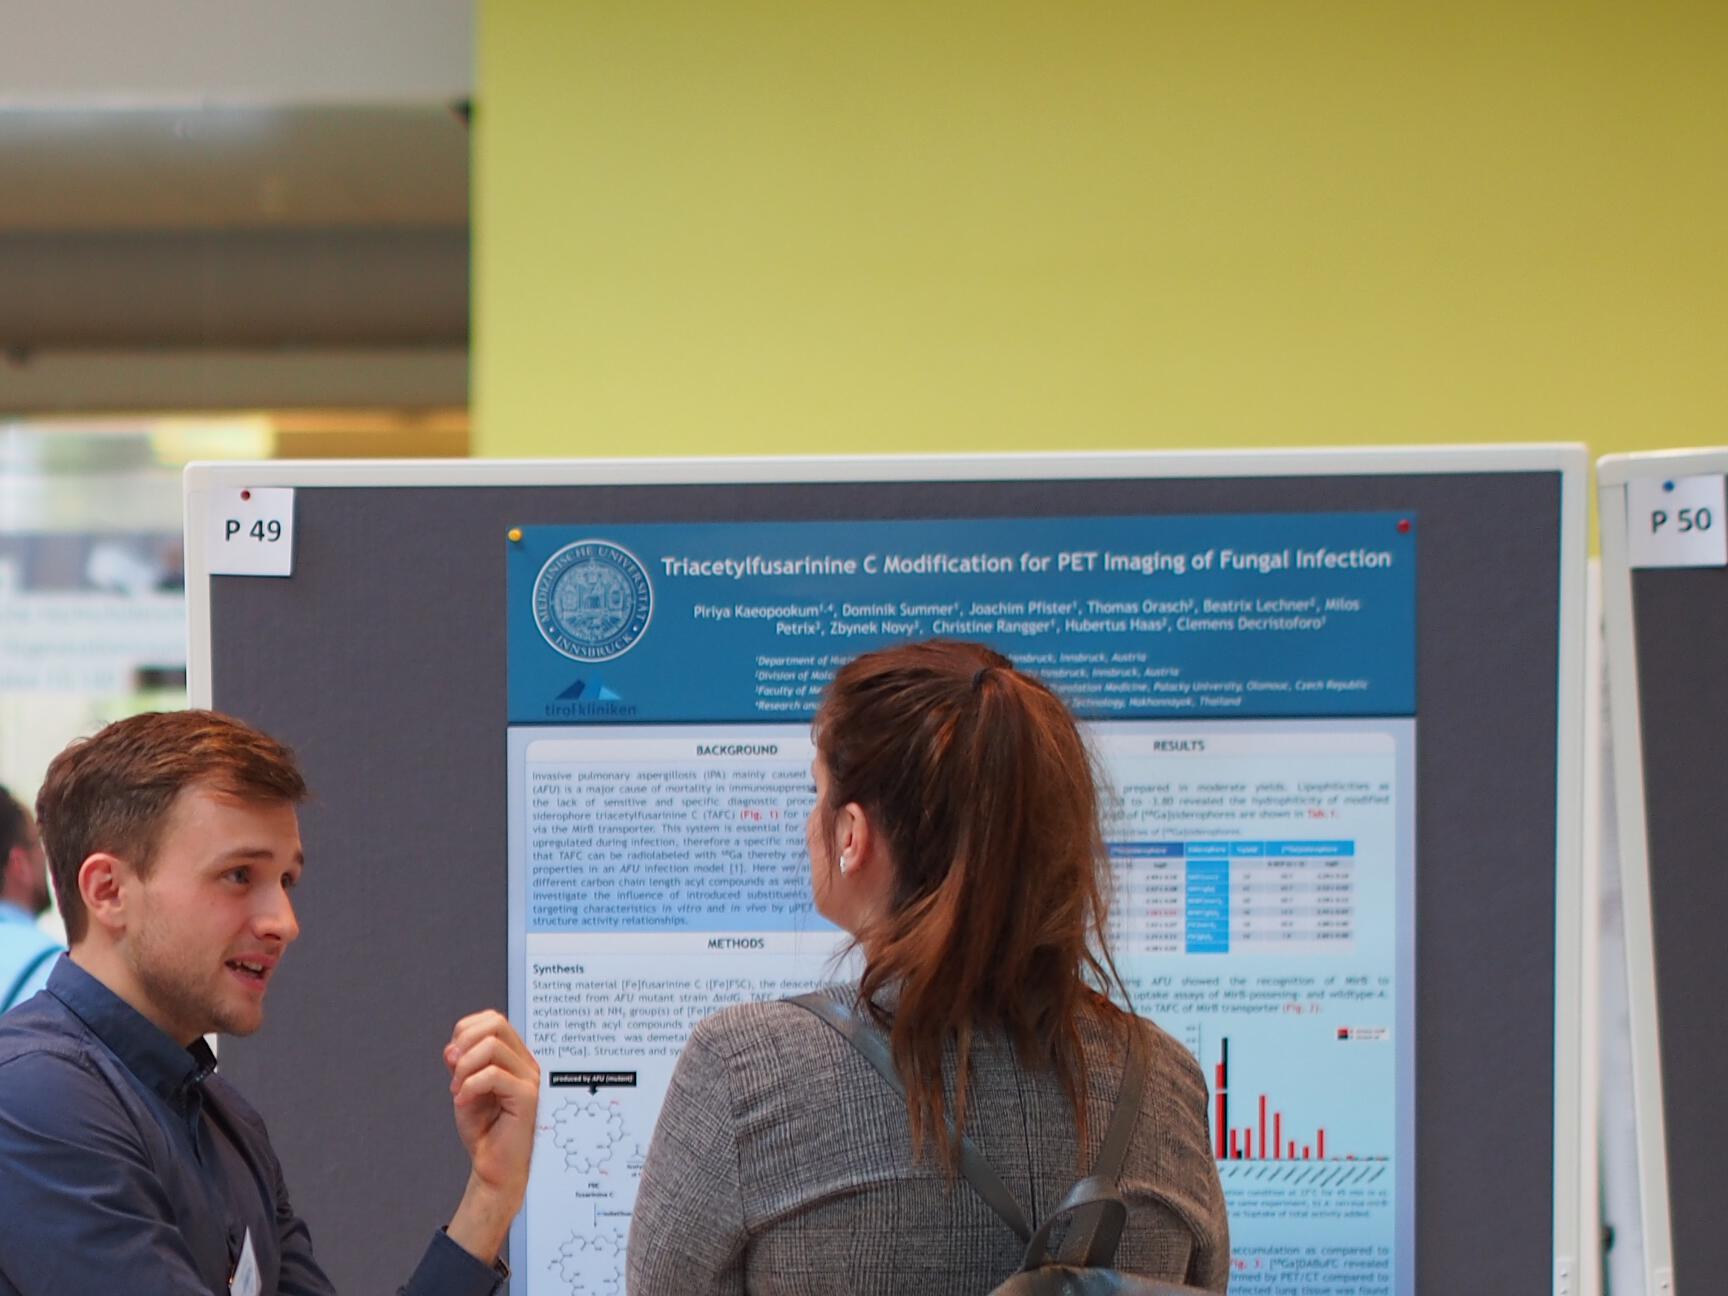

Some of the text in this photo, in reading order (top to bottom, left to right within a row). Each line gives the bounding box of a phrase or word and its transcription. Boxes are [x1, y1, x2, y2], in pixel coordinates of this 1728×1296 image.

[1651, 507, 1712, 534] P 50
[225, 519, 282, 542] P 49
[660, 548, 1391, 578] Triacetylfusarinine C Modification for PET Imaging of Fungal Infection
[537, 546, 593, 624] MEDIZINISCHE
[693, 604, 731, 621] Piriya
[842, 602, 896, 617] Dominik
[968, 602, 1024, 615] Joachim
[1086, 599, 1138, 614] Thomas
[1203, 598, 1252, 613] Beatrix
[1324, 597, 1360, 611] Milos
[829, 620, 877, 637] Zbynek
[932, 619, 993, 634] Christine
[1065, 618, 1126, 632] Hubertus
[1176, 616, 1234, 631] Clemens
[556, 633, 634, 658] INNSBRUCK
[696, 745, 778, 755] BACKGROUND
[1153, 740, 1205, 751] RESULTS
[532, 771, 572, 780] Invasive
[577, 771, 630, 782] pulmonary
[636, 770, 696, 781] aspergillosis
[732, 770, 765, 780] mainly
[771, 769, 806, 778] caused
[532, 811, 591, 822] siderophore
[783, 809, 798, 818] for
[551, 824, 568, 834] the
[660, 823, 681, 833] This
[685, 825, 719, 835] system
[735, 823, 779, 832] essential
[784, 823, 799, 832] for
[532, 838, 592, 849] upregulated
[595, 837, 627, 849] during
[743, 836, 780, 848] specific
[532, 851, 552, 860] that
[587, 852, 605, 860] can
[609, 851, 622, 860] be
[627, 850, 689, 860] radiolabeled
[694, 850, 717, 859] with
[747, 849, 786, 861] thereby
[532, 865, 584, 875] properties
[602, 865, 615, 873] an
[644, 863, 688, 873] infection
[693, 863, 724, 872] model
[752, 863, 776, 873] Here
[532, 877, 577, 887] different
[580, 877, 615, 887] carbon
[618, 877, 645, 887] chain
[648, 877, 680, 888] length
[708, 876, 764, 888] compounds
[532, 905, 578, 916] targeting
[582, 904, 656, 914] characteristics
[706, 903, 725, 913] and
[771, 903, 784, 914] by
[532, 915, 688, 927] structure activity relationships.
[707, 938, 764, 949] METHODS
[532, 964, 584, 975] Synthesis
[532, 980, 617, 991] Starting material
